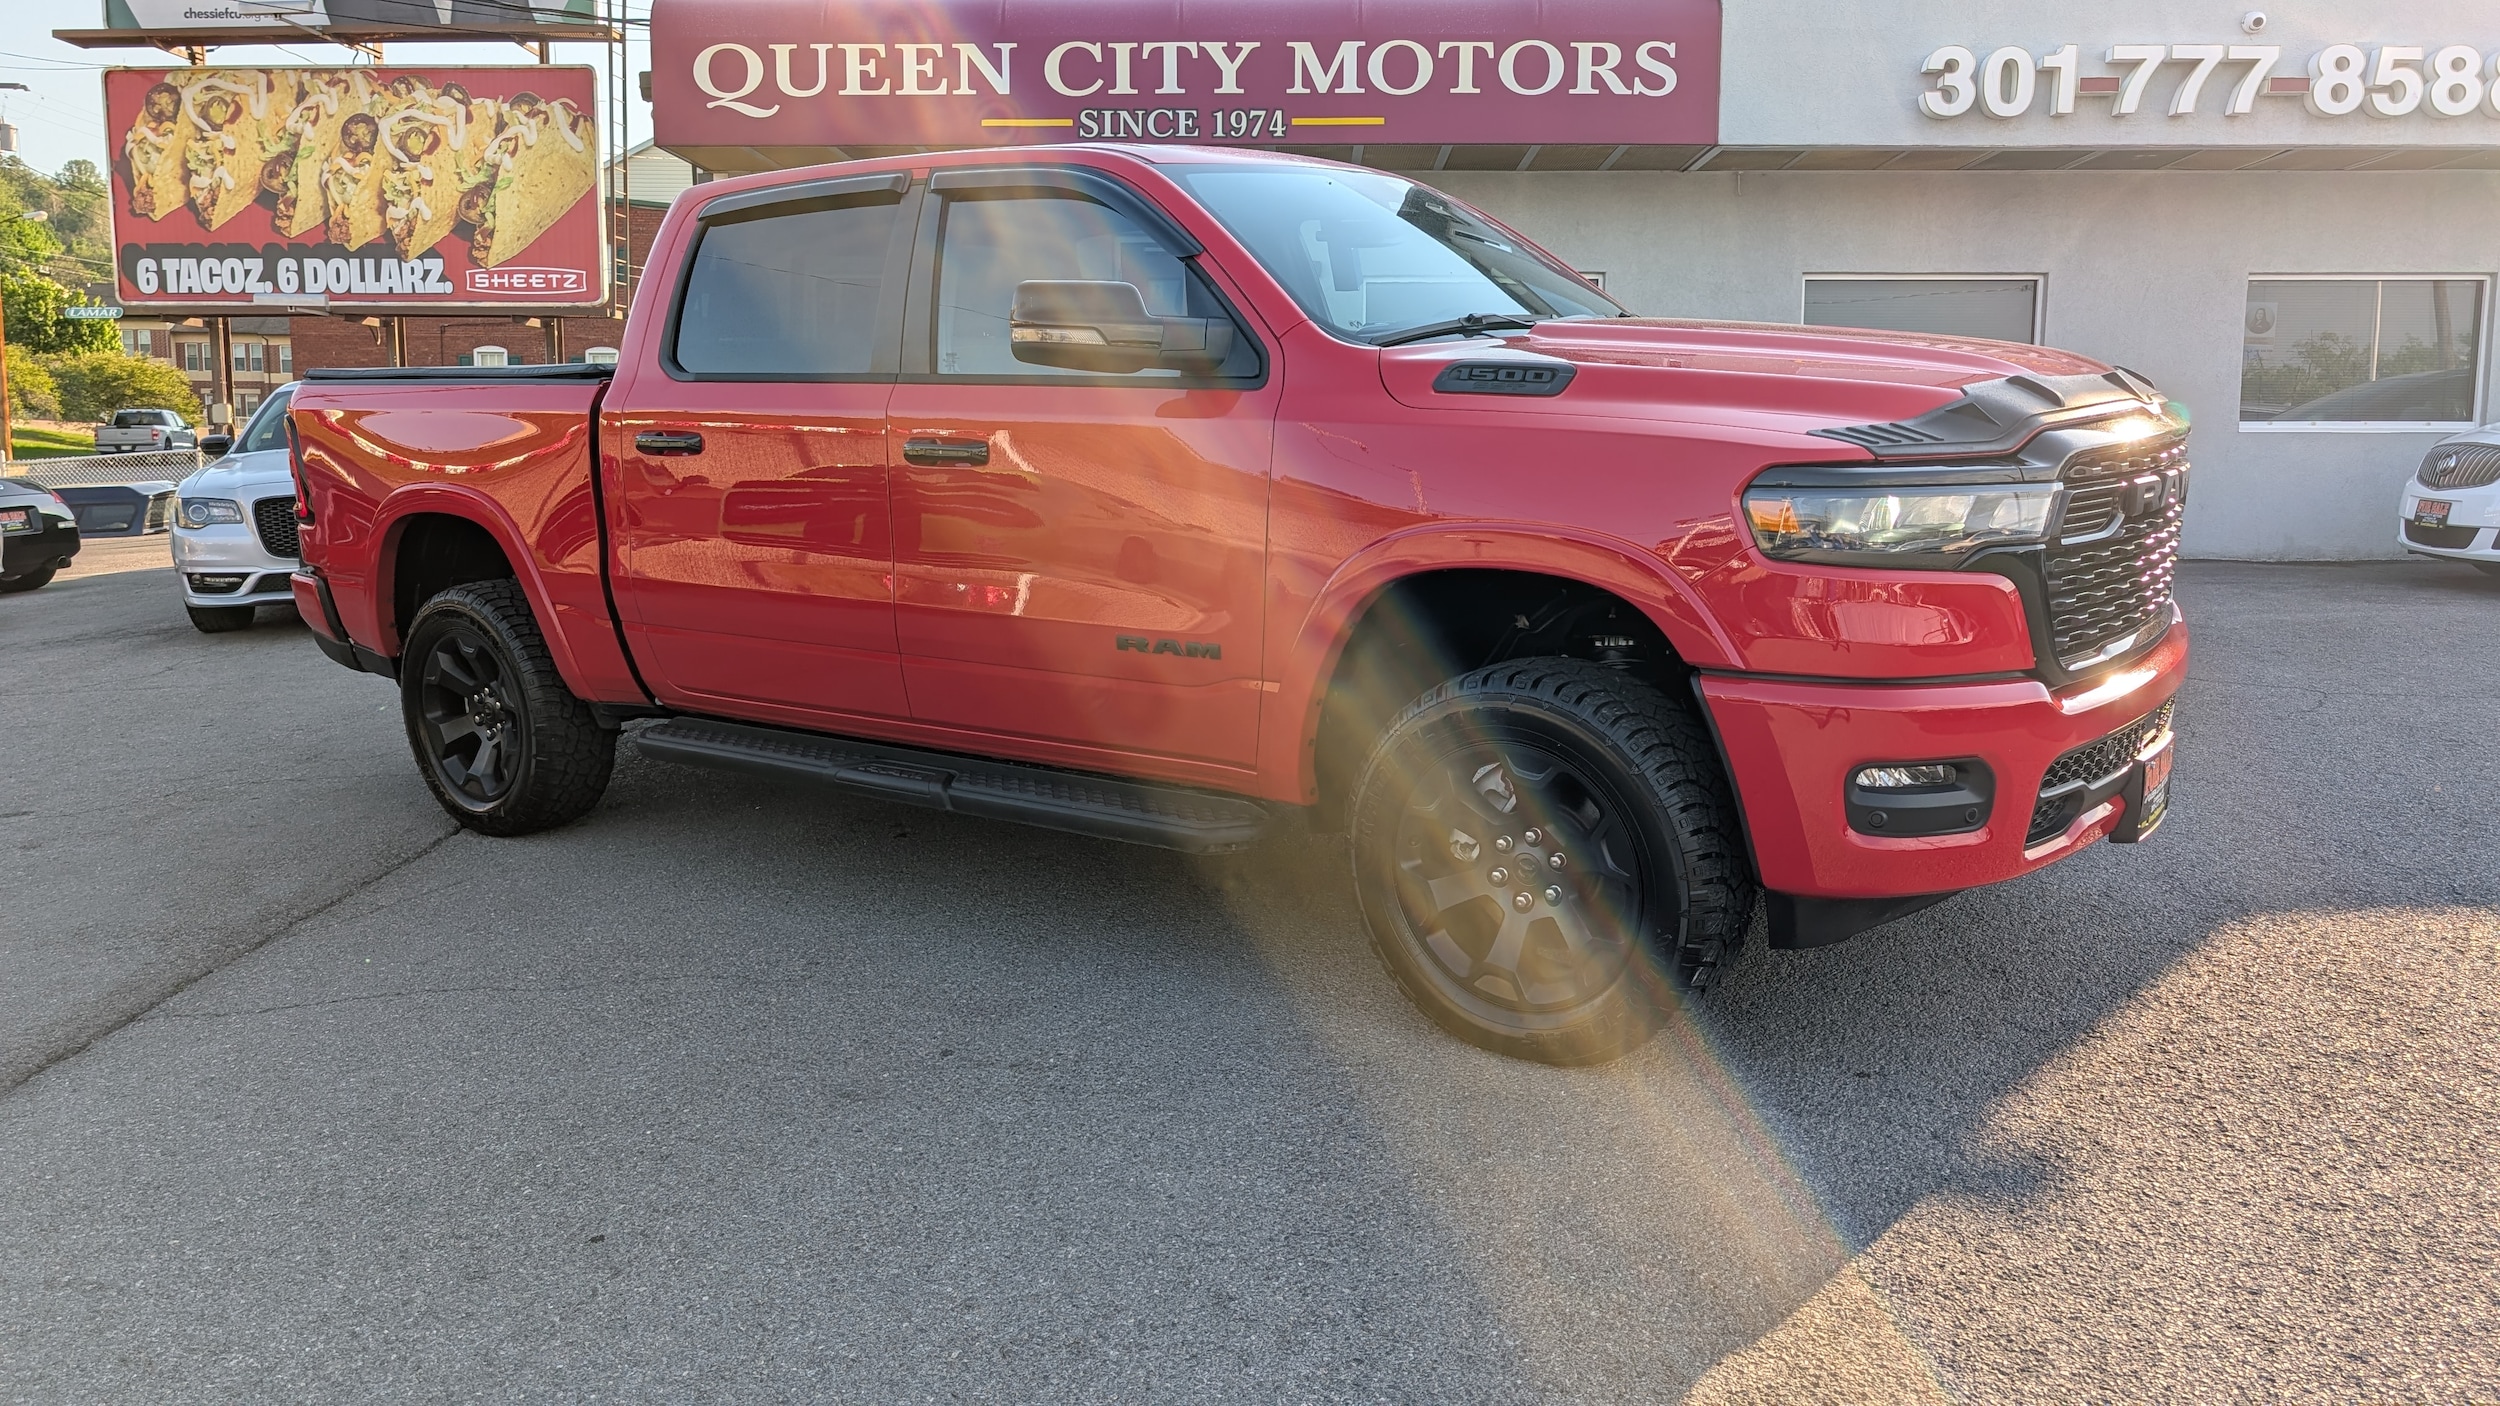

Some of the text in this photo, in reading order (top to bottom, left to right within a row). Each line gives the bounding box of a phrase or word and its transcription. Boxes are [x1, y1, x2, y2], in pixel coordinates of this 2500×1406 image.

[693, 39, 1678, 118] QUEEN CITY MOTORS
[1919, 43, 2500, 118] 301-777-858
[1078, 108, 1288, 138] SINCE 1974
[136, 257, 454, 294] 6 TACOZ. 6 DOLLARZ.
[475, 273, 578, 288] SHEETZ
[70, 309, 118, 317] LAMAR
[1456, 367, 1551, 382] 1500
[1115, 635, 1222, 660] RAM
